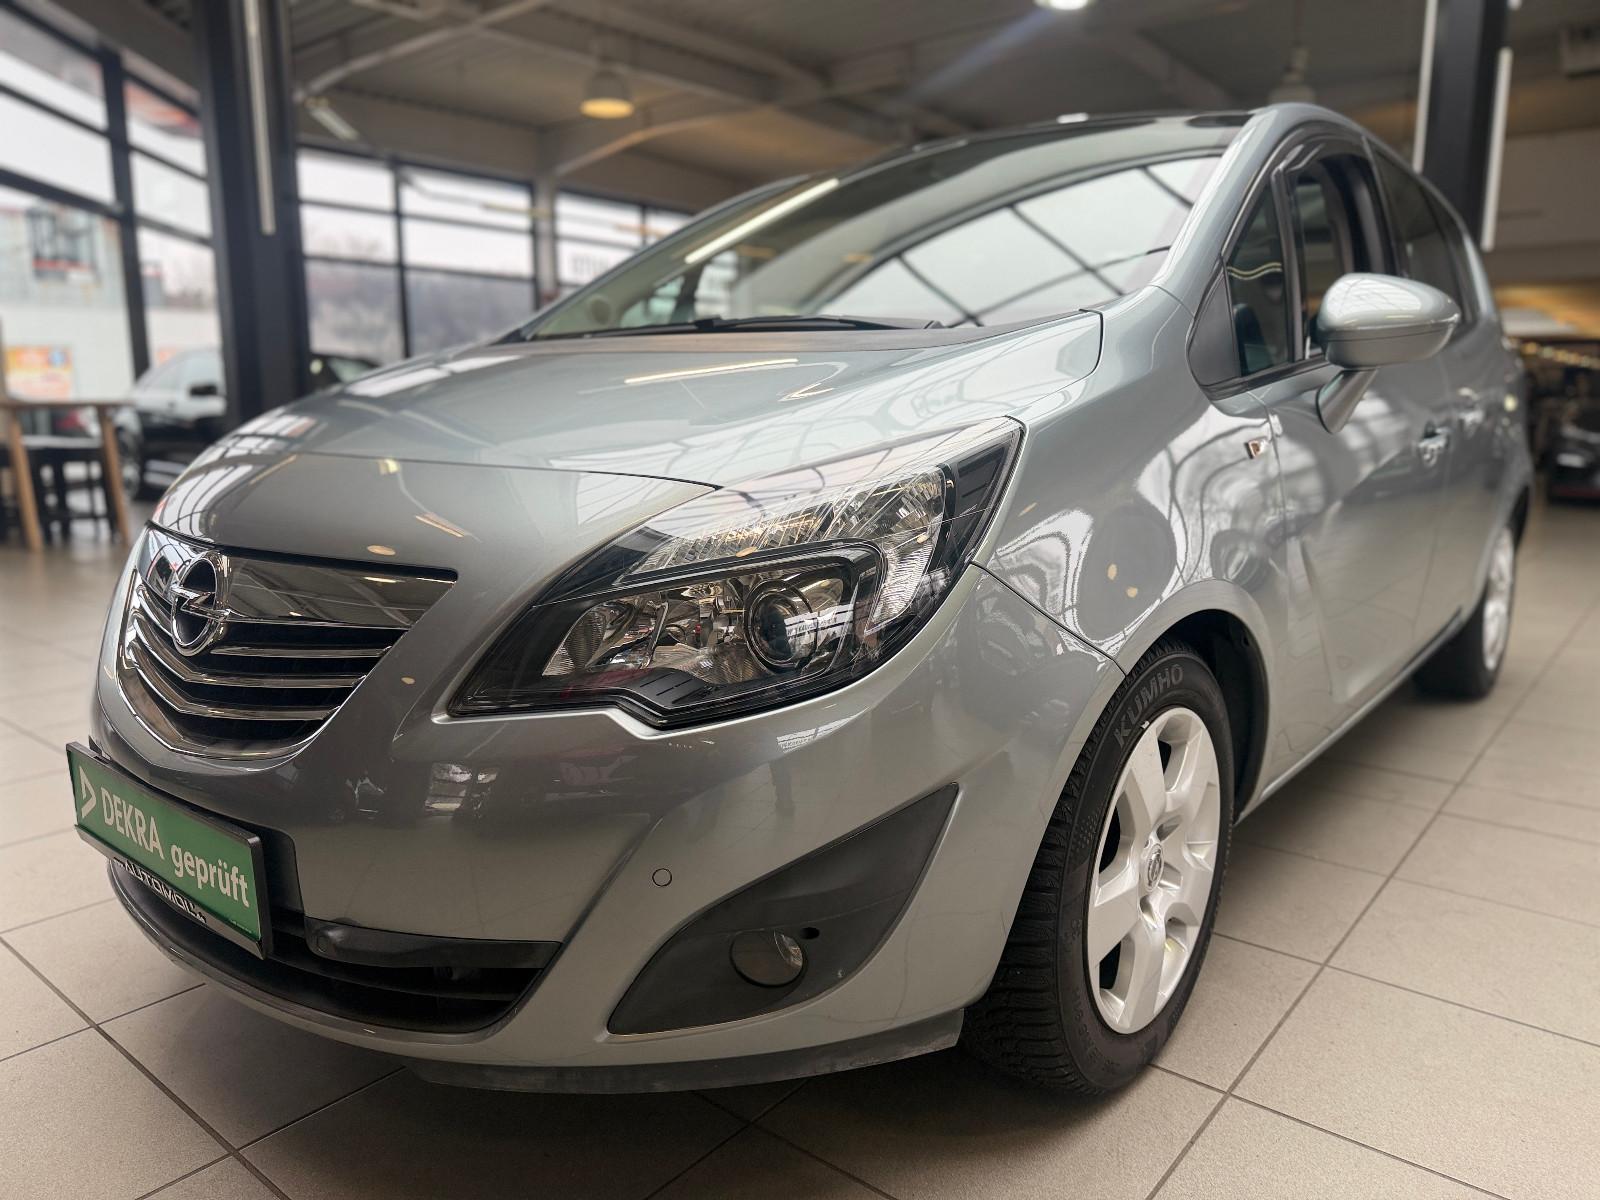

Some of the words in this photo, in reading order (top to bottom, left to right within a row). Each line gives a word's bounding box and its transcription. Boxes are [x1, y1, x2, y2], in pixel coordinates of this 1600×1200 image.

[1114, 664, 1184, 748] KUMHO
[101, 787, 165, 860] DEKRA
[171, 845, 249, 908] geprüft
